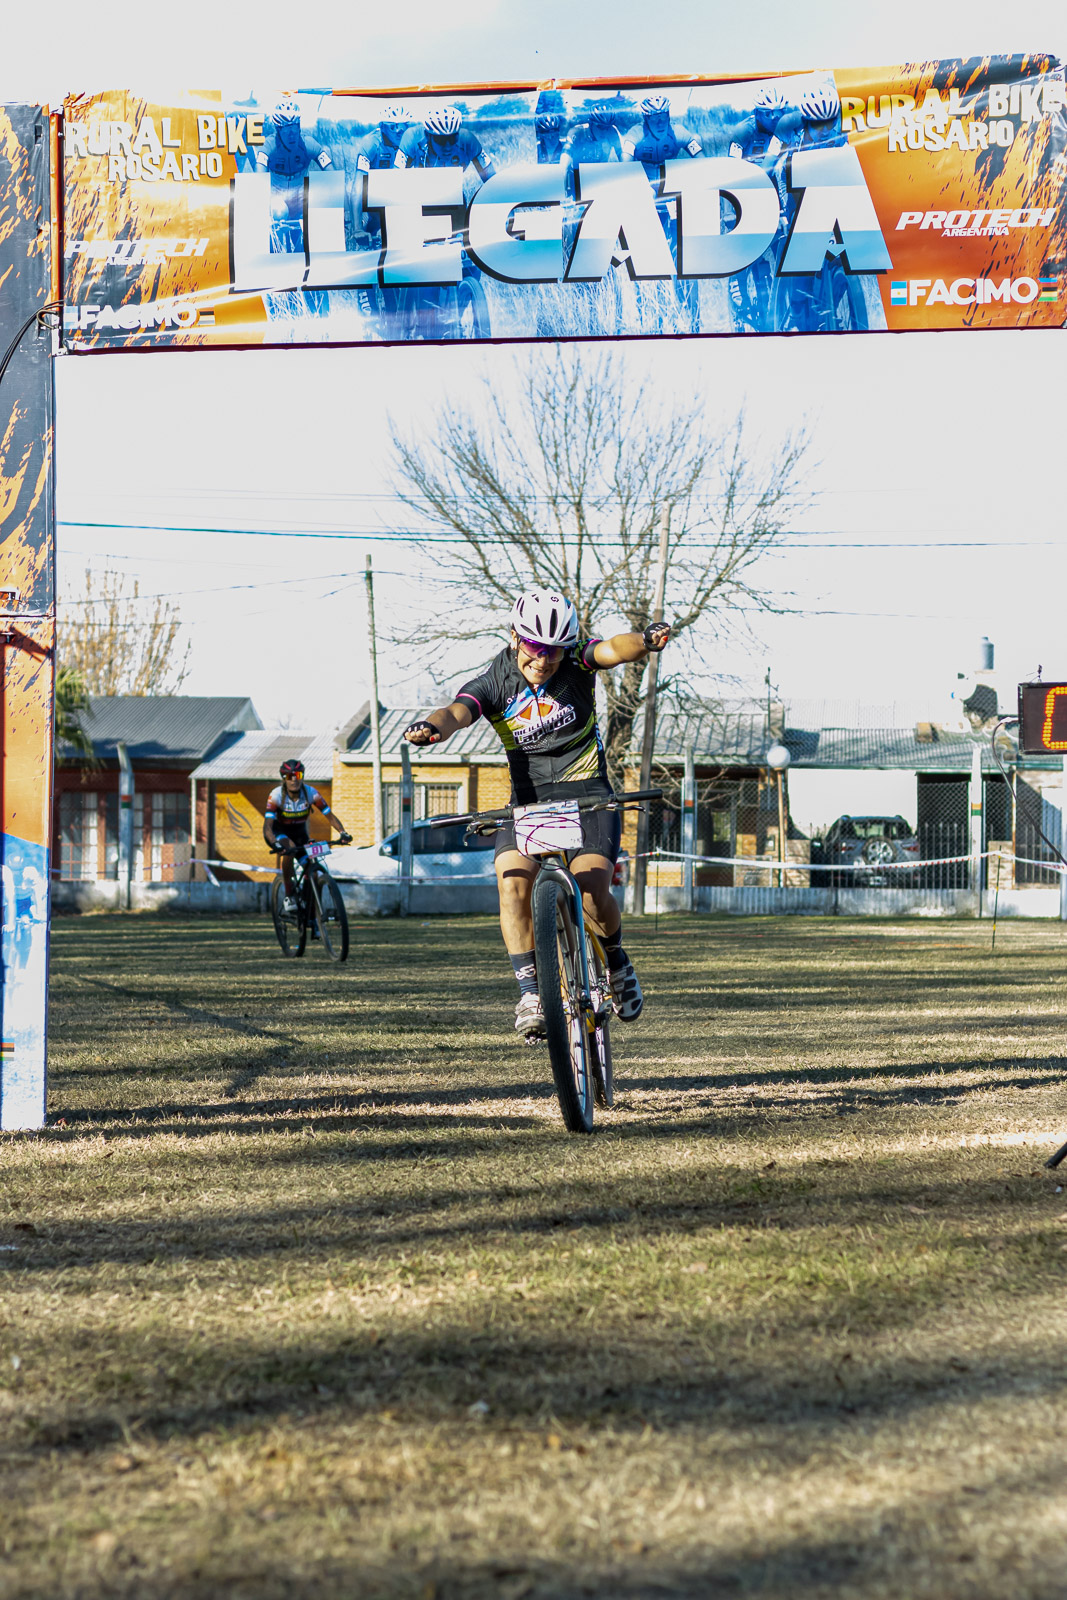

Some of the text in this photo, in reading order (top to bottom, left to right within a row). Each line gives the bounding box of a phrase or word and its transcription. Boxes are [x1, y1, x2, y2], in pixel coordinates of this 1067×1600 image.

[841, 83, 1065, 132] RURAL BIKE
[65, 113, 266, 158] RURAL BIKE
[888, 120, 1014, 153] ROSARIO
[108, 152, 223, 183] ROSARIO
[230, 145, 894, 294] LLEGADA
[895, 207, 1057, 231] PROTECH
[941, 226, 1010, 238] ARGENTINA
[909, 276, 1039, 307] FACIMO
[80, 302, 197, 330] FACIMO
